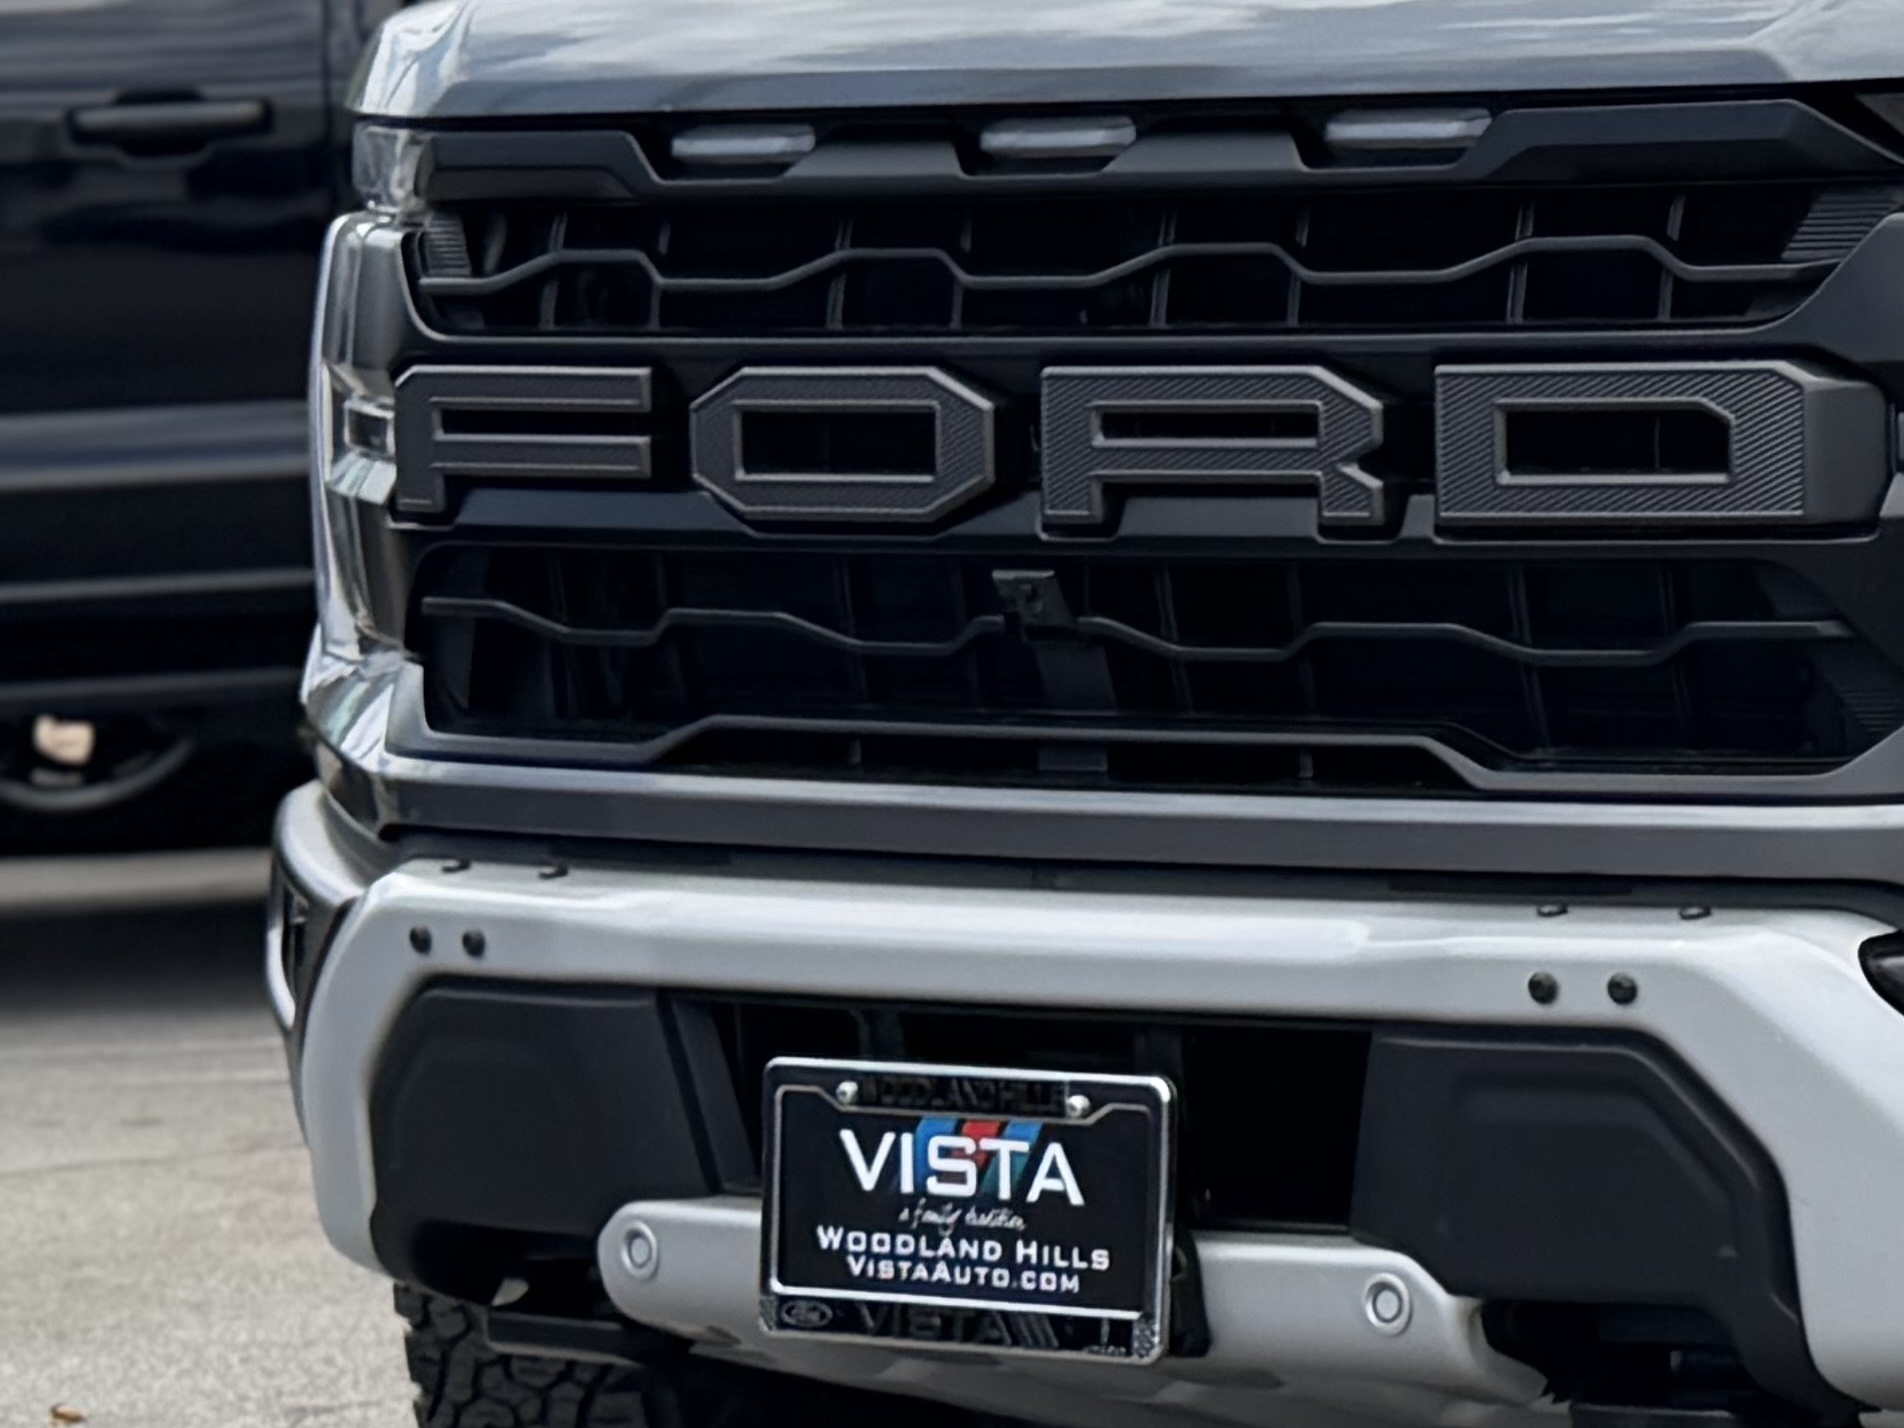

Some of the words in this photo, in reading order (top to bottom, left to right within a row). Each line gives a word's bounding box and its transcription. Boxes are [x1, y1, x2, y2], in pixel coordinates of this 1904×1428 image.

[392, 360, 1882, 540] FORD
[840, 1129, 1085, 1206] VISTA
[816, 1224, 1003, 1261] WOODLAND
[1015, 1238, 1111, 1271] HILLS
